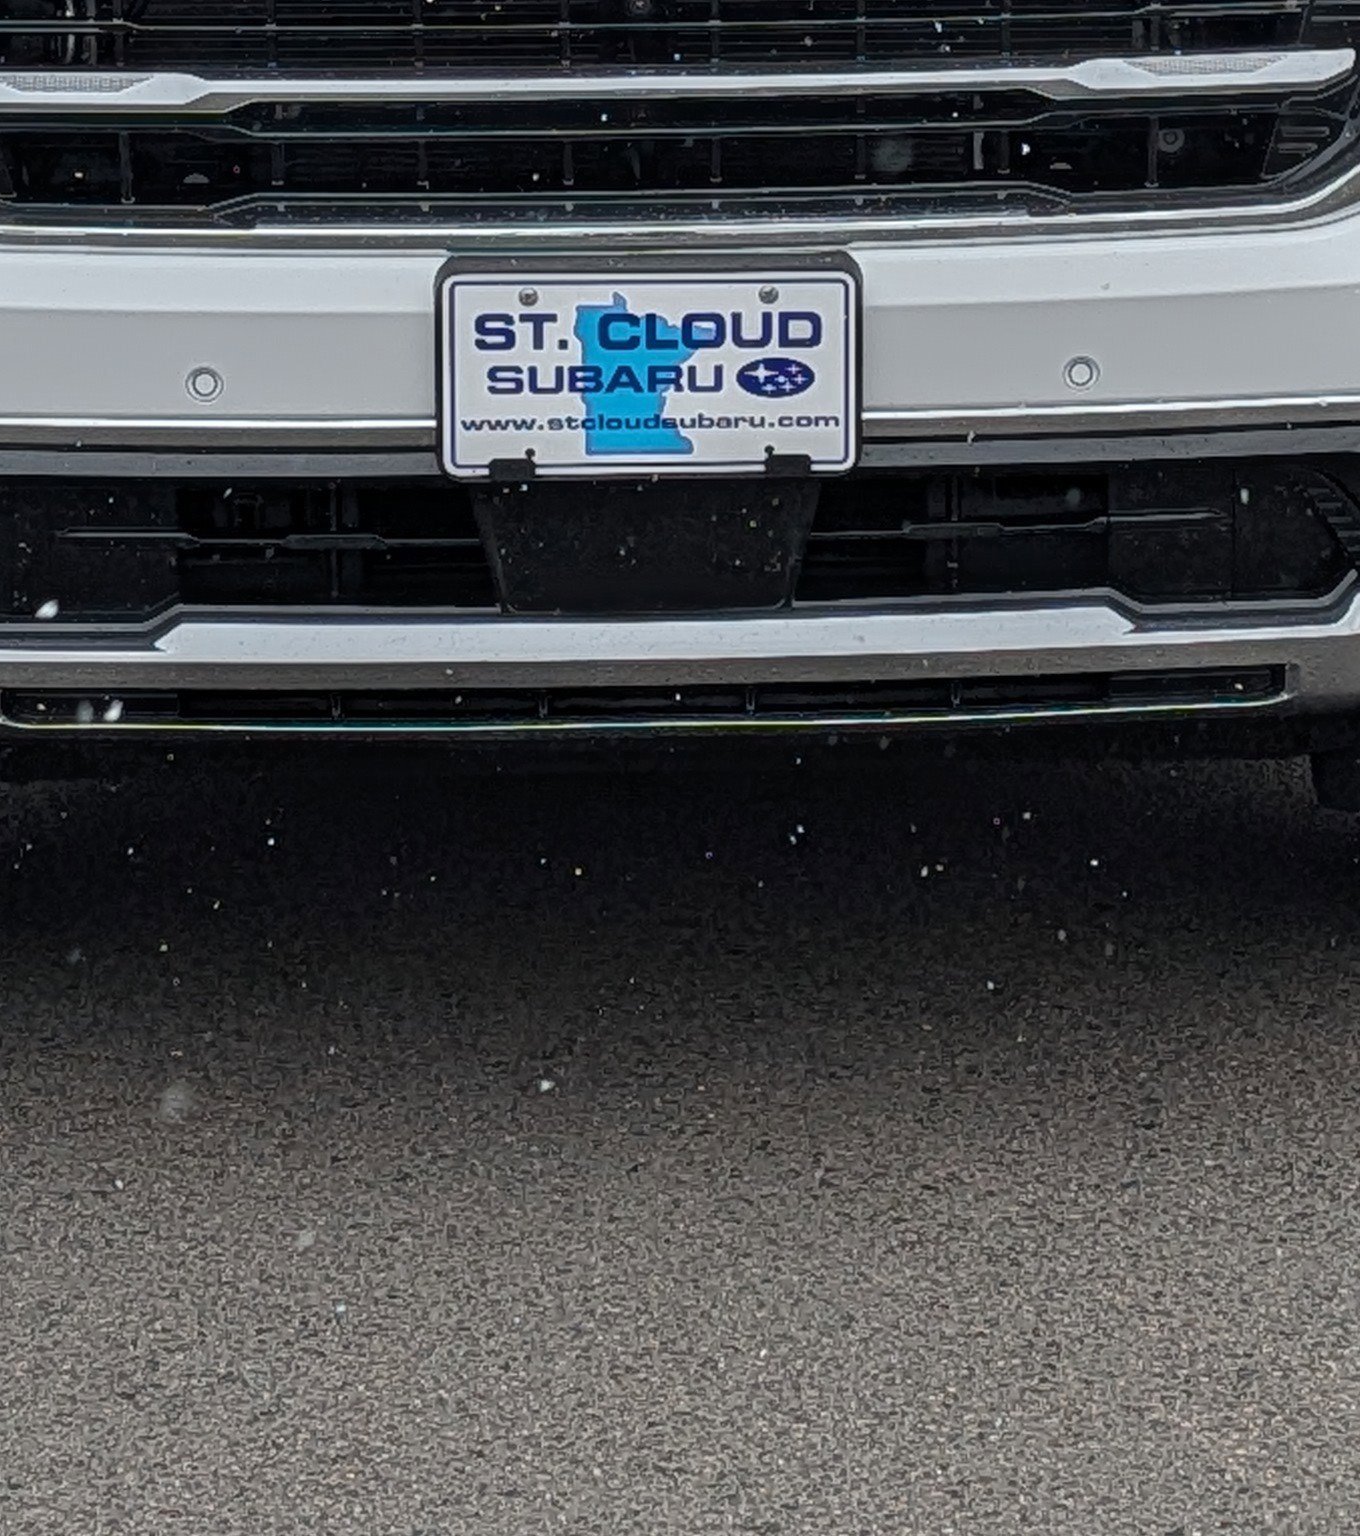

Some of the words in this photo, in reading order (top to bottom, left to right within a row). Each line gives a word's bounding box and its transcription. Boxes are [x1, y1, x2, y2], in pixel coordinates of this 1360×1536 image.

[474, 312, 569, 351] ST.
[598, 311, 822, 351] CLOUD
[487, 364, 723, 395] SUBARU
[461, 413, 840, 431] www.stcloudsubaru.com
